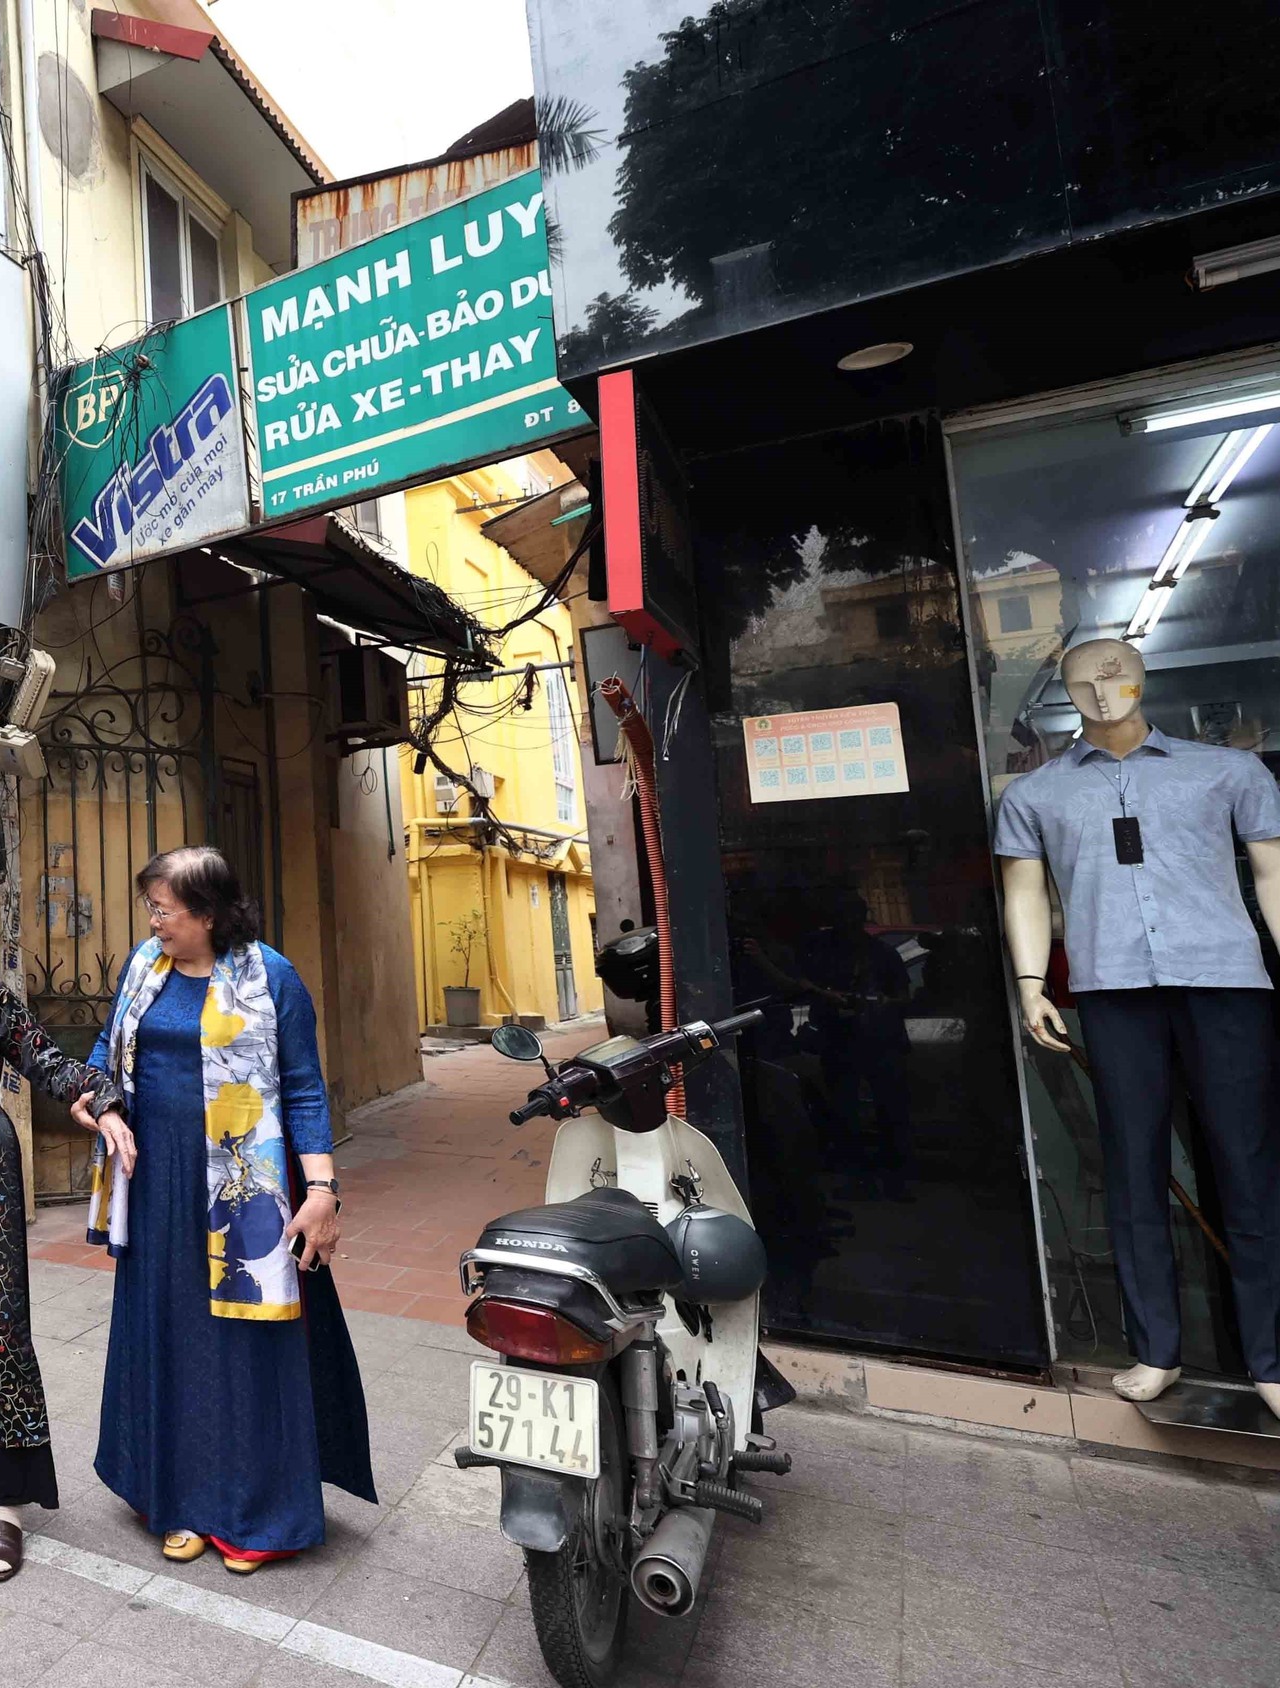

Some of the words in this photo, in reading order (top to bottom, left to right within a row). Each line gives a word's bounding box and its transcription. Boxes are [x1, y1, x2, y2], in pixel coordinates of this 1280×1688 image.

[261, 249, 412, 343] MẠNH
[256, 353, 319, 403] SỬA
[76, 384, 119, 433] BP
[264, 401, 343, 452] RỬA
[524, 406, 554, 428] ĐT
[70, 372, 235, 569] Vistra
[135, 518, 159, 547] Ước
[180, 465, 202, 493] của
[203, 433, 228, 466] mọi
[271, 490, 288, 507] 17
[293, 472, 340, 500] TRẦN
[343, 458, 380, 484] PHÚ
[159, 527, 173, 546] xe
[173, 498, 196, 530] gắn
[196, 464, 223, 499] máy
[495, 1238, 568, 1252] HONDA
[690, 1249, 700, 1280] OWEN
[489, 1372, 576, 1422] 29-K1
[478, 1411, 588, 1469] 571.44
